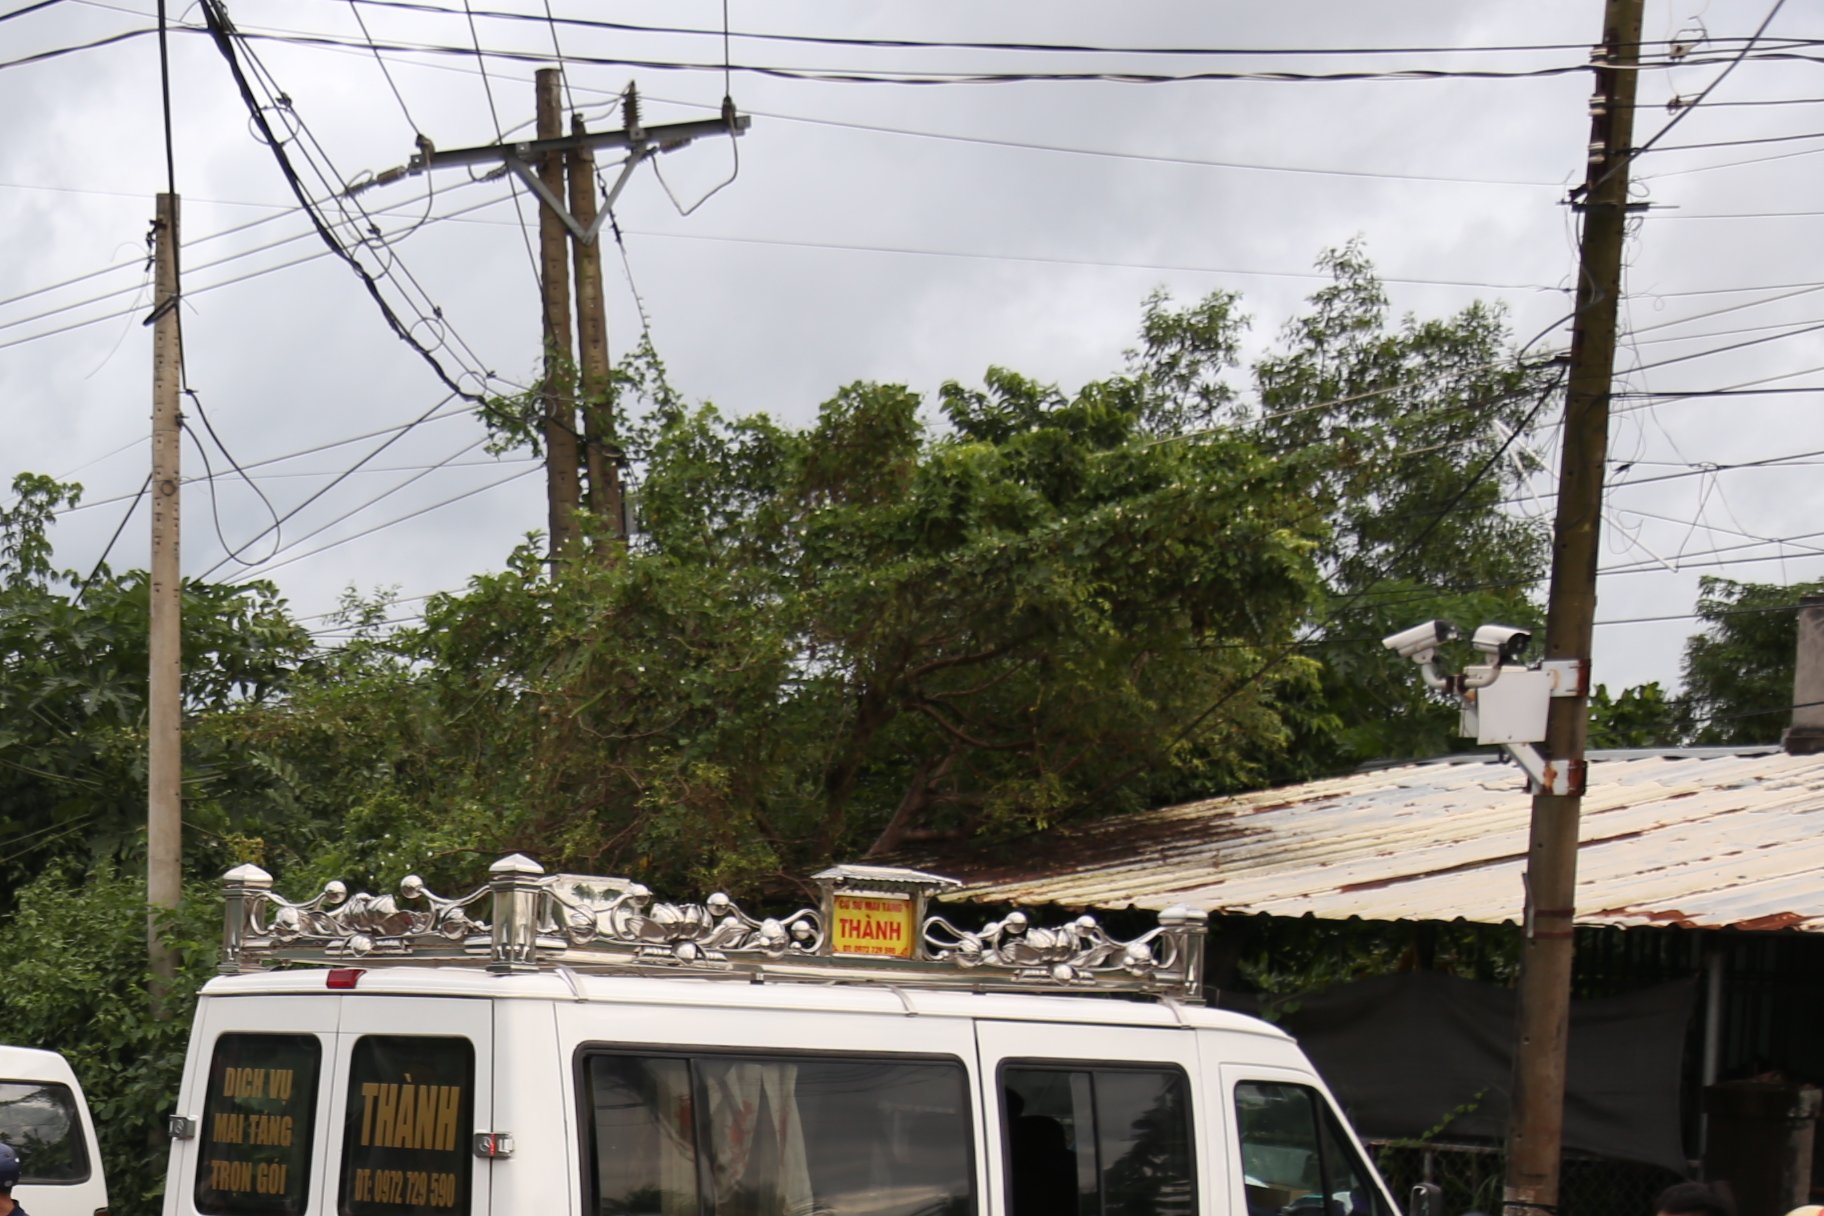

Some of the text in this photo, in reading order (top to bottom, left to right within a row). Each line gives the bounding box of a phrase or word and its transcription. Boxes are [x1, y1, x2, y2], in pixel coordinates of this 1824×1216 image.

[839, 914, 902, 941] THÀNH
[270, 1069, 294, 1105] VỤ
[213, 1110, 294, 1147] MAI TÁNG
[360, 1073, 462, 1152] THÀNH
[211, 1159, 287, 1197] TRỌN GÓI
[374, 1169, 404, 1204] 0972
[406, 1171, 428, 1206] 729
[430, 1173, 456, 1208] 590
